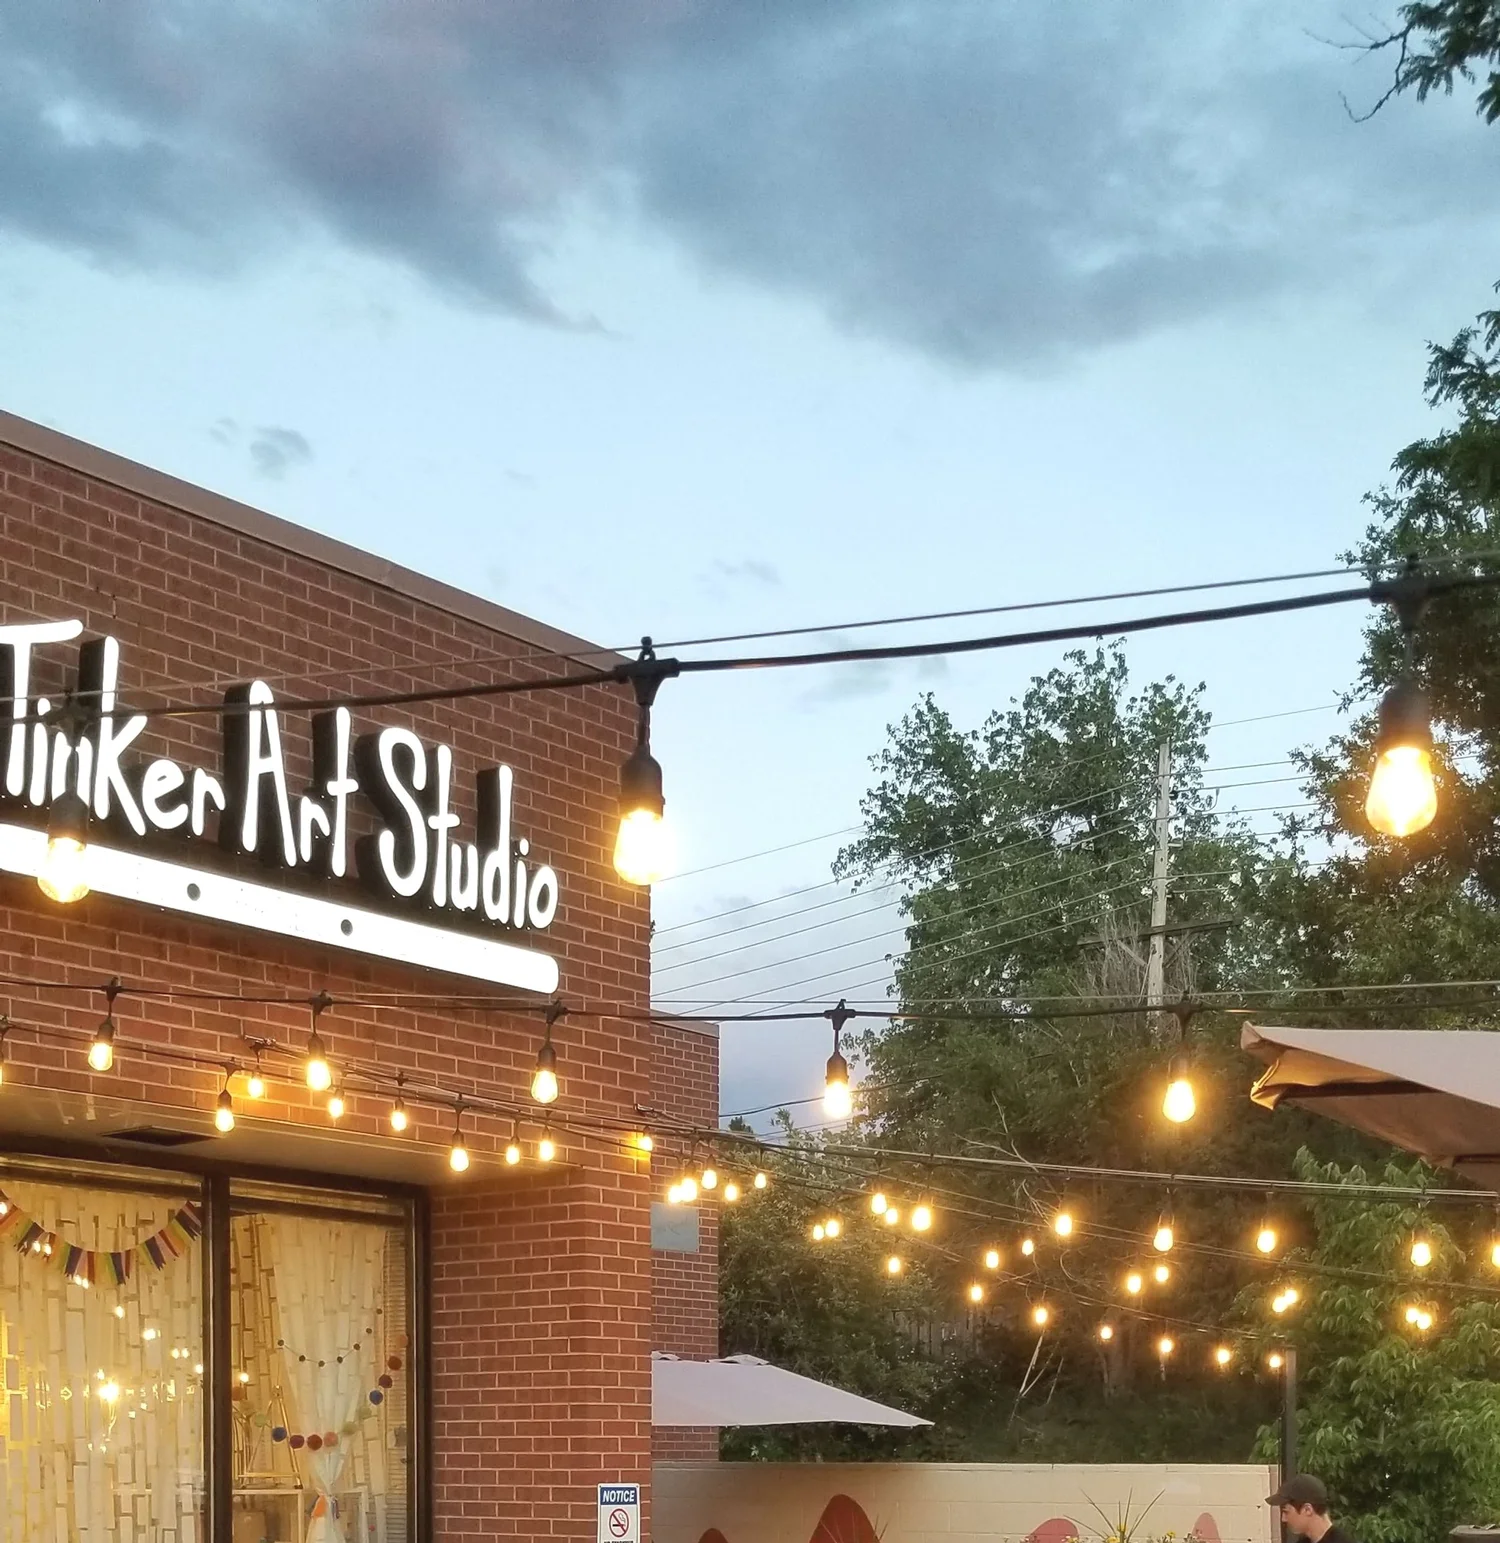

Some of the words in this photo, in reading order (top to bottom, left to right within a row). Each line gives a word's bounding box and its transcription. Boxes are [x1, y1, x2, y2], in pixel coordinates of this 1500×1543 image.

[0, 618, 226, 836] Tinker
[242, 679, 360, 878] Art
[378, 726, 559, 929] Studio
[602, 1490, 636, 1503] NOTICE
